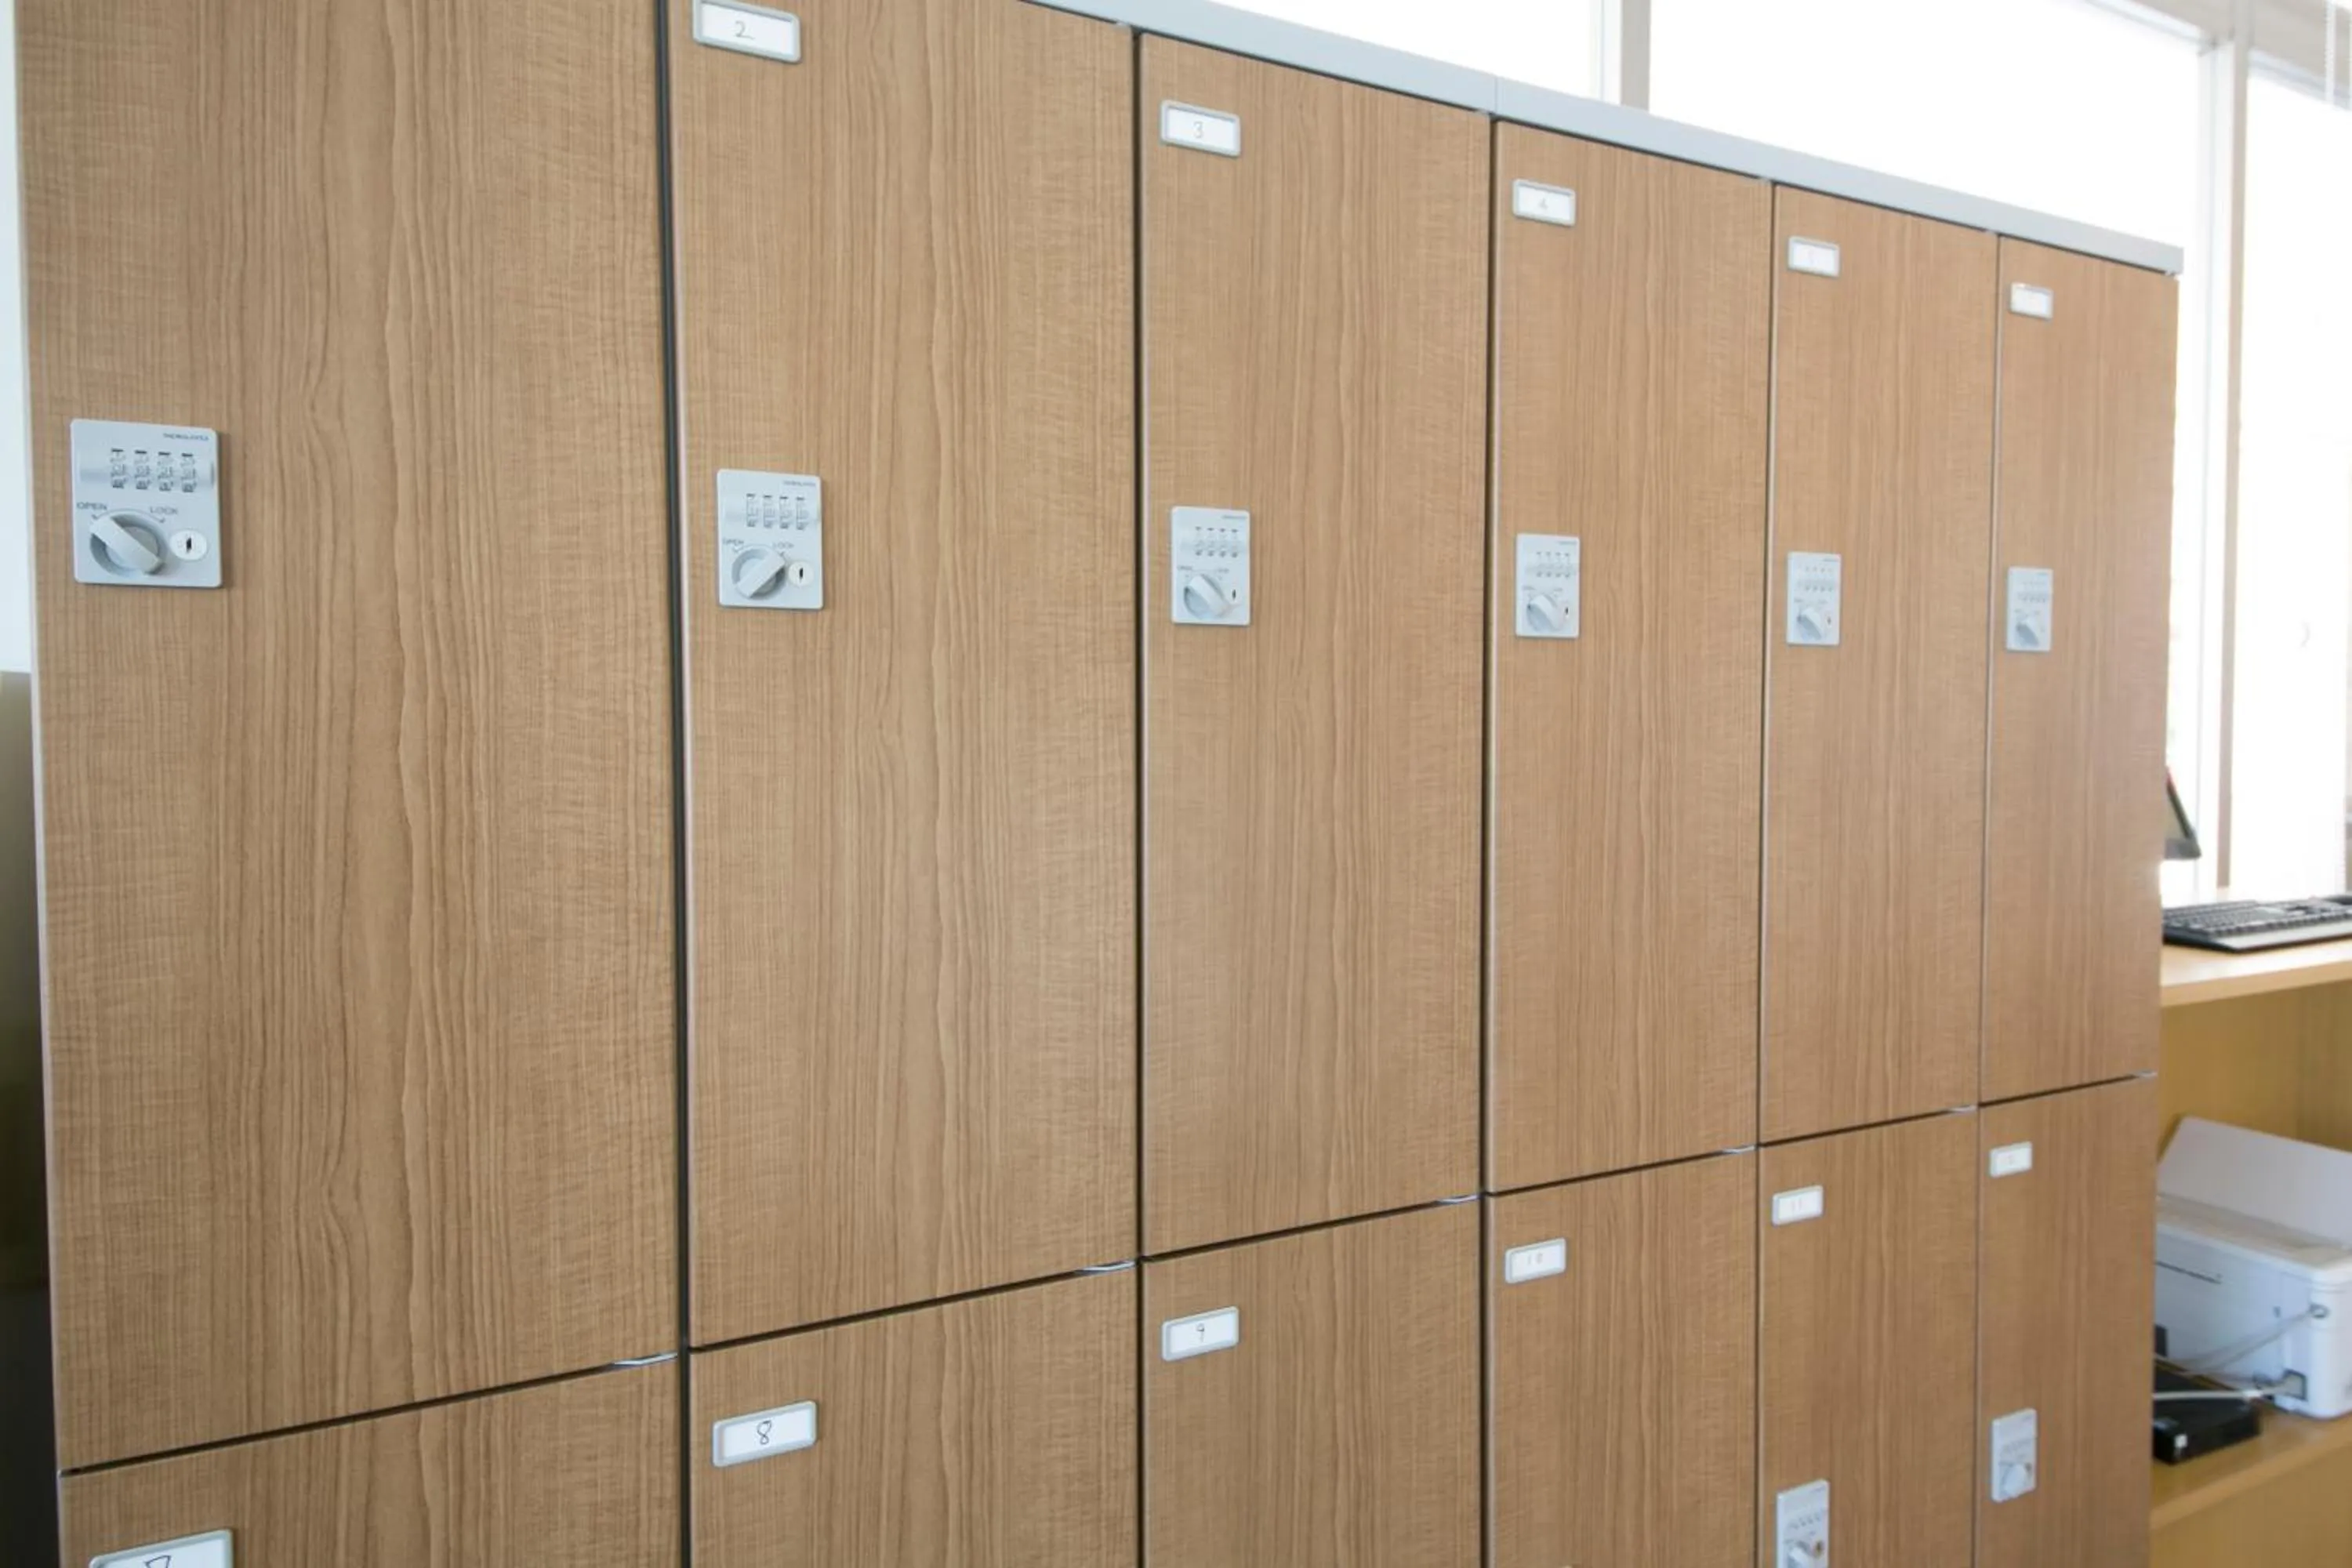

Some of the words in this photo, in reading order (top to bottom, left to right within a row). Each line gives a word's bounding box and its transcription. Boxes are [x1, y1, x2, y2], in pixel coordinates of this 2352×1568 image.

[735, 20, 756, 40] 2
[1193, 121, 1204, 139] 3
[77, 502, 107, 511] OPEN
[149, 506, 178, 515] LOCK
[1196, 1323, 1205, 1342] 9
[757, 1420, 771, 1445] 8
